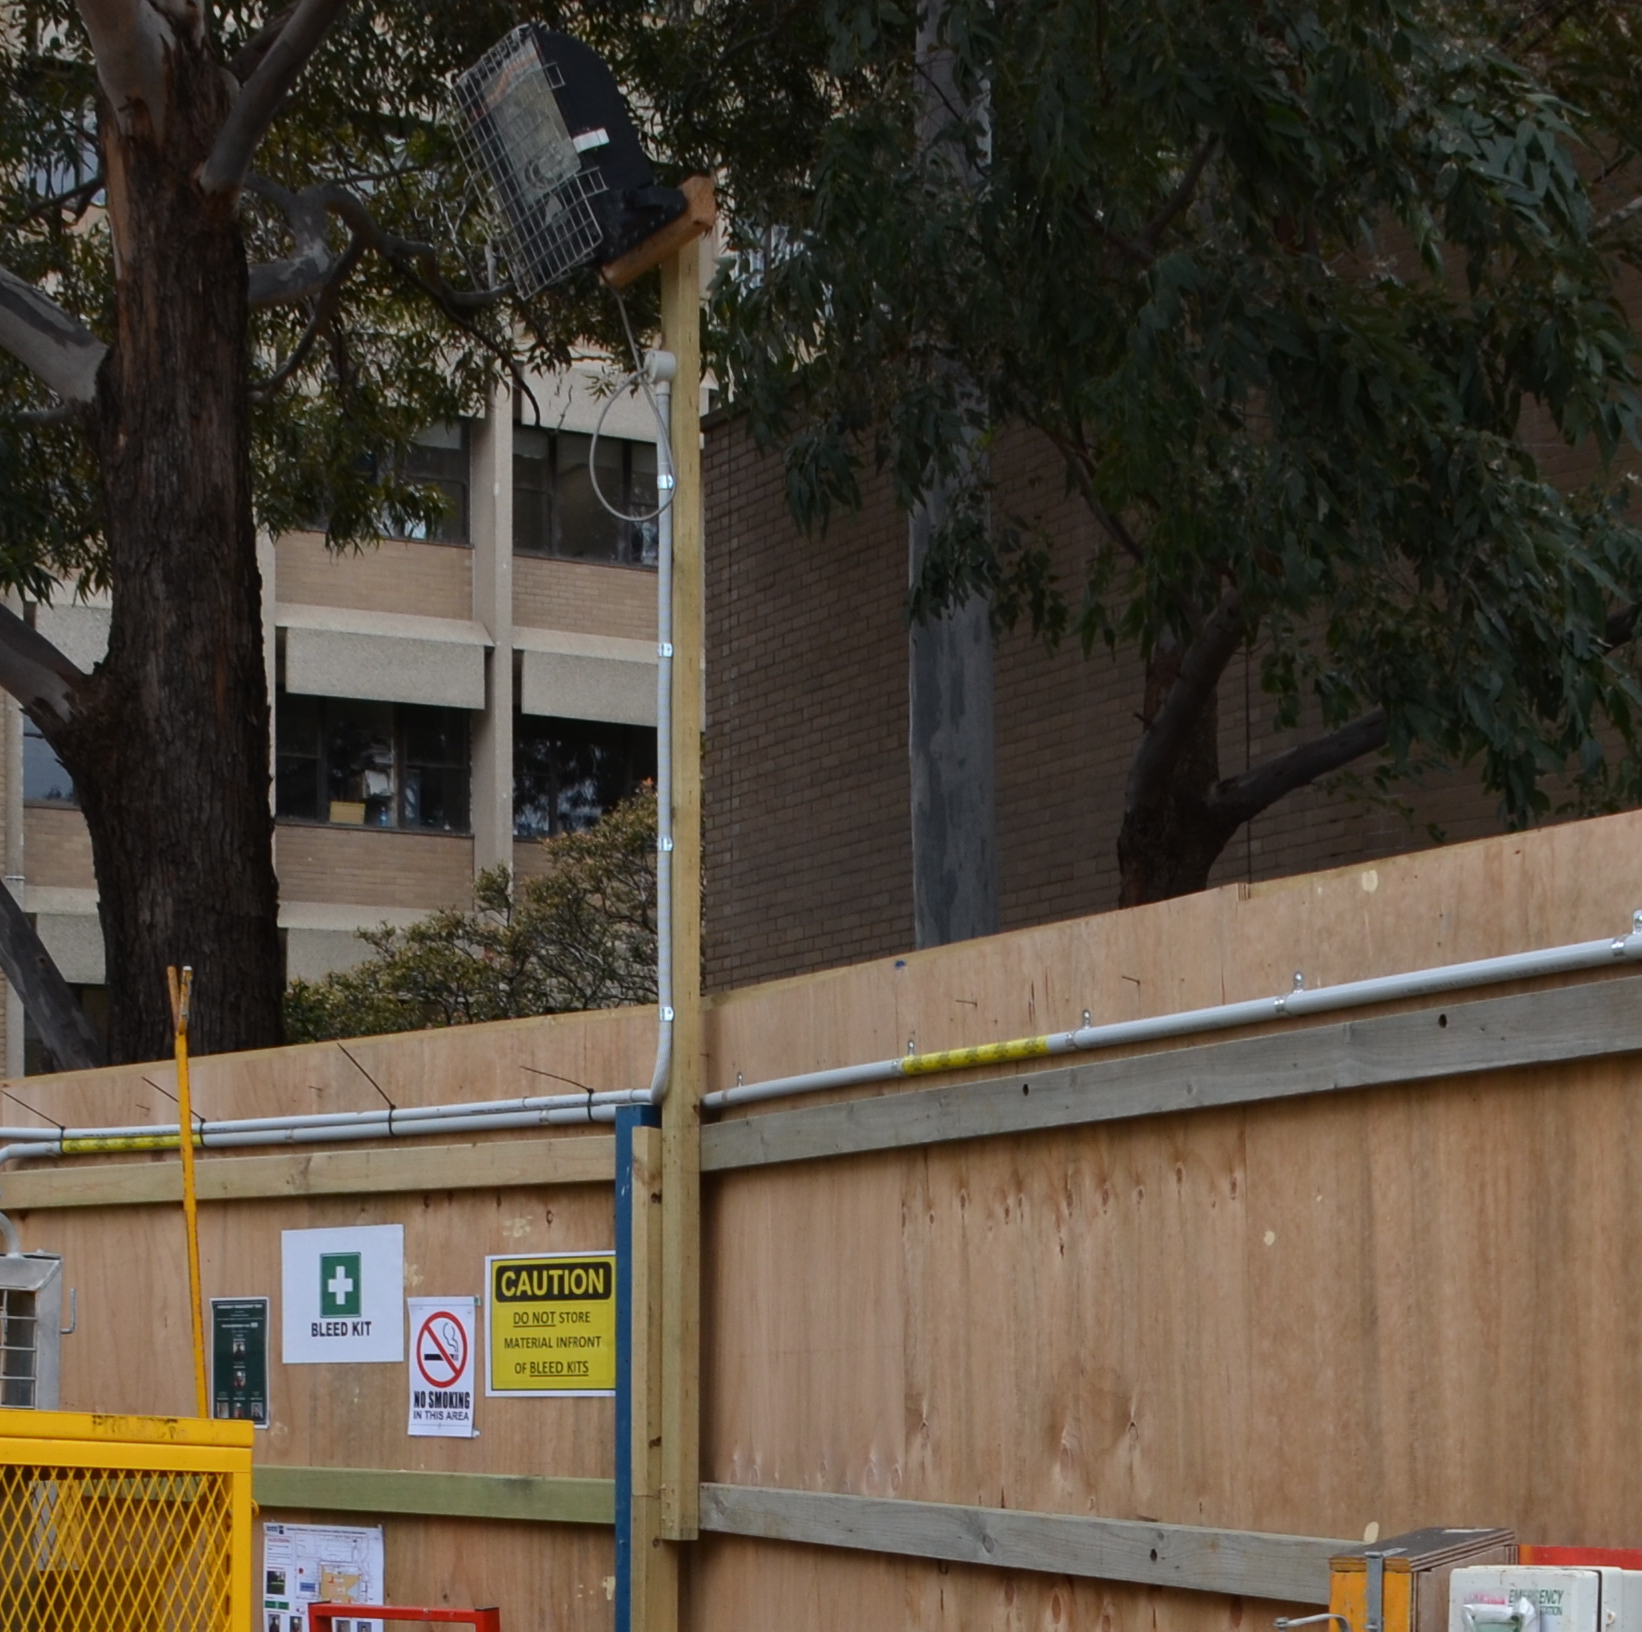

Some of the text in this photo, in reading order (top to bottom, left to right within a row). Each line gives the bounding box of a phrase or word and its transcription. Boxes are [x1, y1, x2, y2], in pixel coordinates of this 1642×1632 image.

[501, 1268, 604, 1297] CAUTION
[513, 1311, 591, 1325] DO NOT STORE
[311, 1321, 372, 1337] BLEED KIT
[504, 1336, 602, 1349] MATERIAL INFRONT
[514, 1360, 589, 1375] OF BLEED KITS
[413, 1390, 471, 1409] NO SMOKING
[413, 1410, 470, 1421] IN THIS AREA
